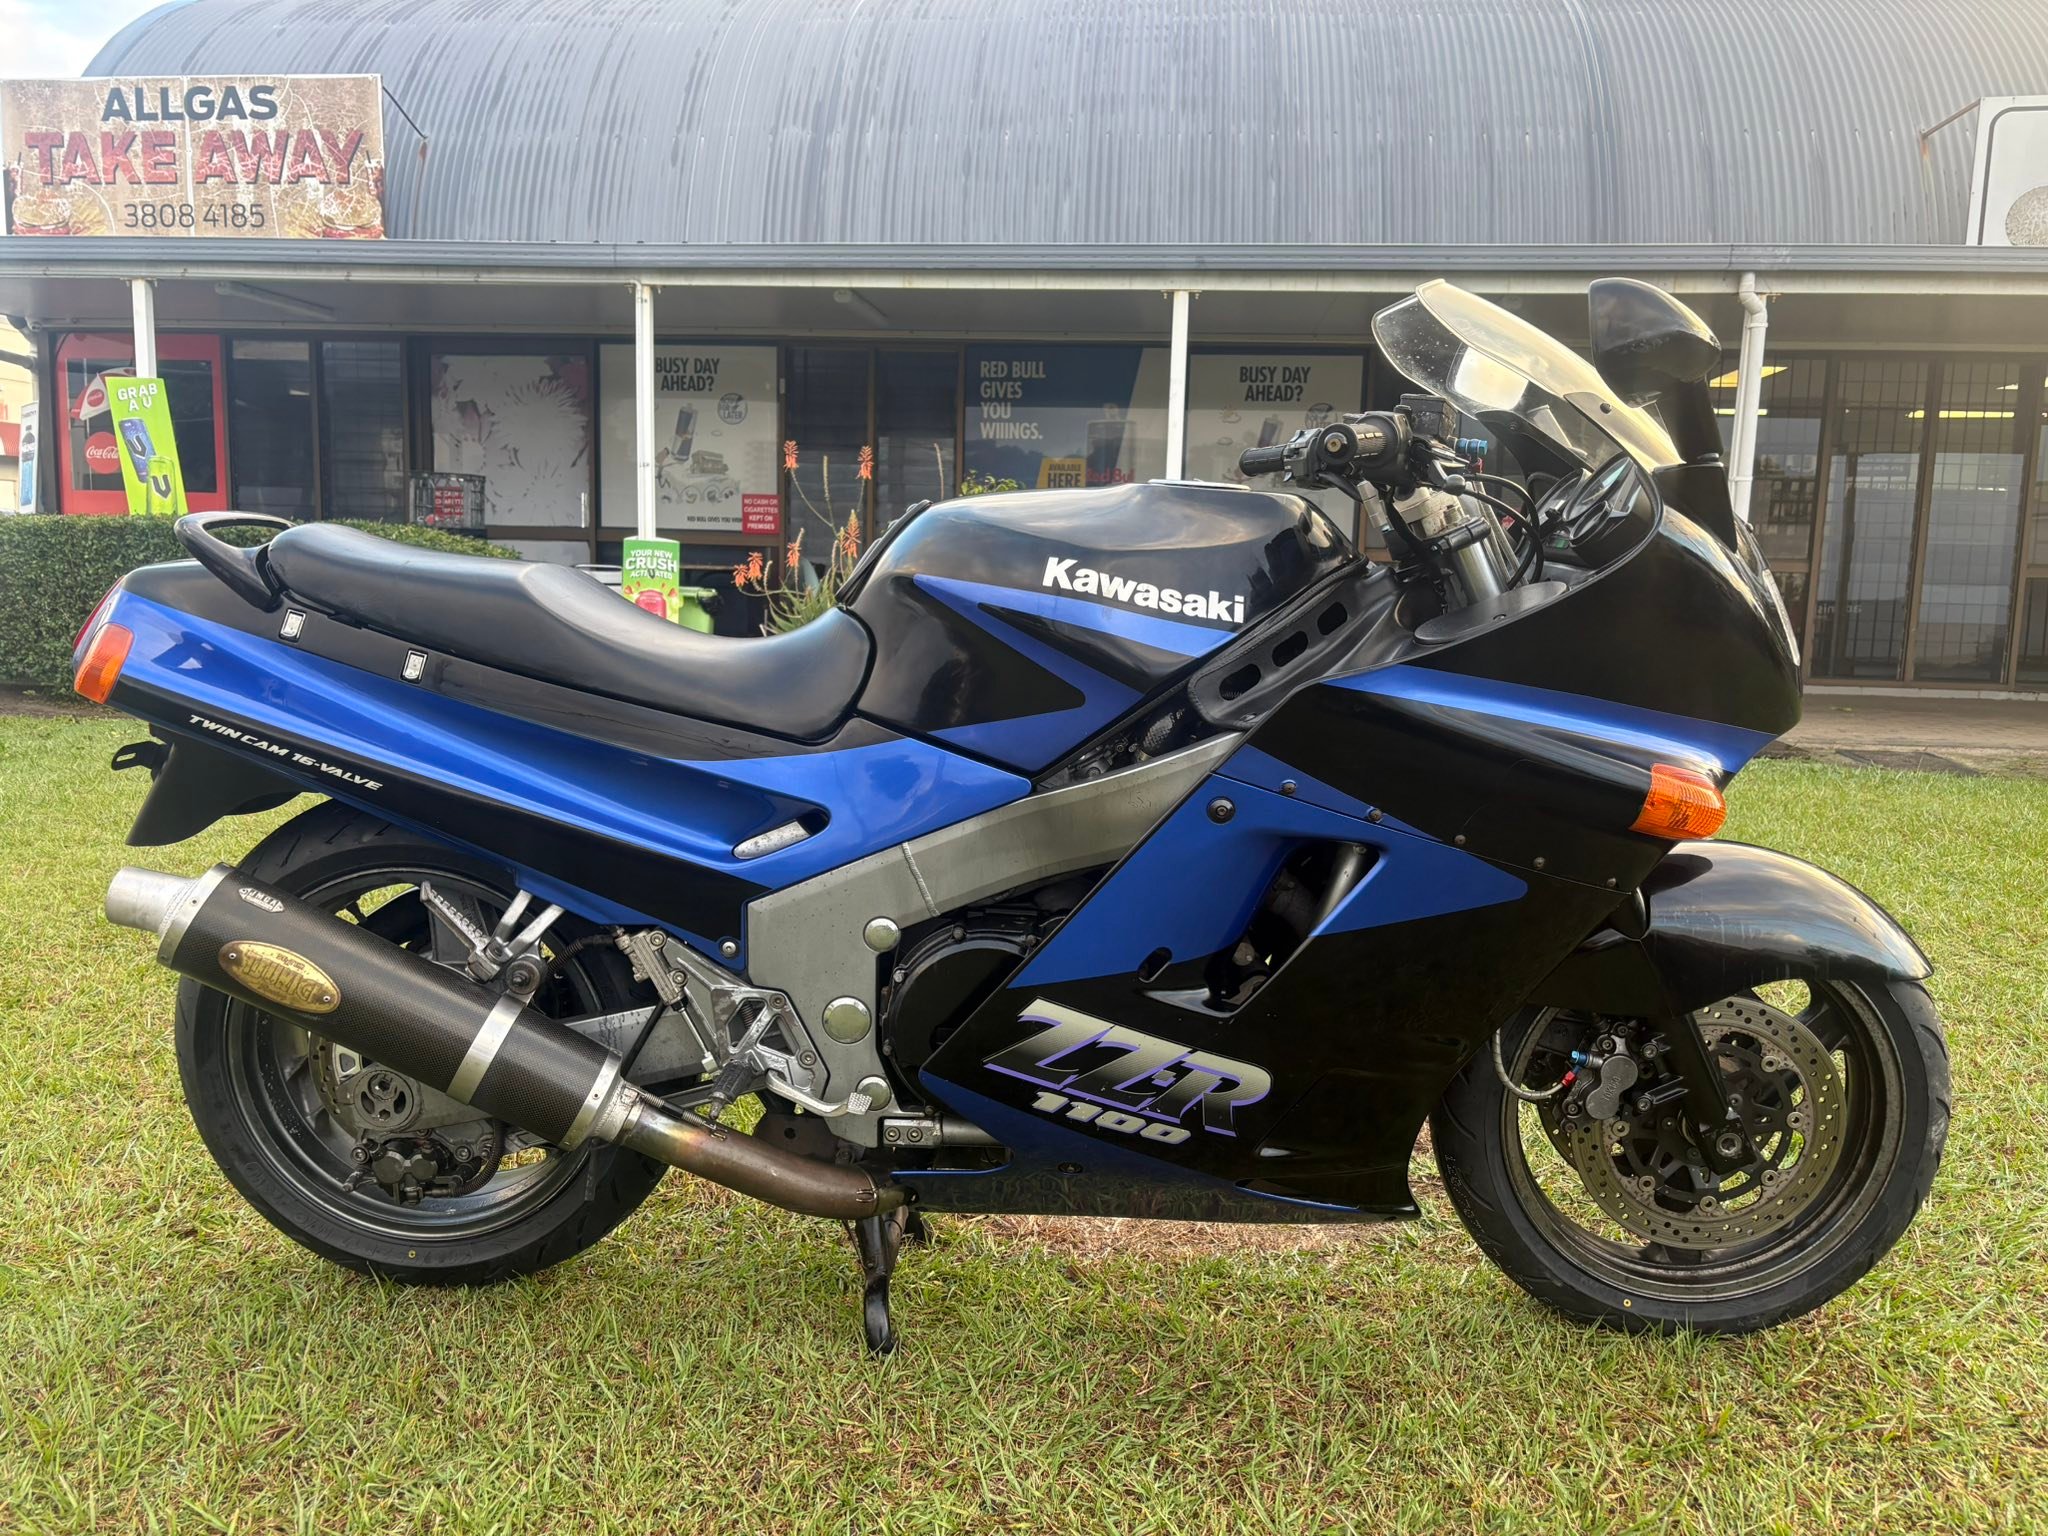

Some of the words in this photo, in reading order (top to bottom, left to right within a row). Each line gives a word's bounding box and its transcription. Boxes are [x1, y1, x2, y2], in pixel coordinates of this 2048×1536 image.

[101, 85, 278, 121] ALLGAS
[24, 130, 178, 185] TAKE
[195, 129, 364, 185] AWAY
[124, 203, 195, 228] 3808
[203, 203, 266, 228] 4185
[656, 358, 689, 374] BUSY
[694, 358, 720, 375] DAY
[980, 361, 1008, 378] RED
[1012, 361, 1046, 379] BULL
[1240, 366, 1278, 383] BUSY
[1282, 366, 1311, 384] DAY
[117, 383, 158, 401] GRAB
[661, 375, 714, 392] AHEAD?
[980, 381, 1023, 399] GIVES
[1245, 385, 1304, 402] AHEAD?
[129, 400, 139, 412] A
[980, 402, 1012, 419] YOU
[980, 422, 1044, 440] WIIINGS.
[1048, 463, 1082, 472] AVAILABLE
[1048, 473, 1082, 488] HERE
[630, 549, 652, 558] YOUR
[654, 550, 673, 559] NEW
[625, 557, 677, 573] CRUSH
[1042, 556, 1245, 624] Kawasaki
[188, 714, 242, 739] TWIN
[240, 735, 290, 757] CAM
[291, 752, 384, 791] 16-VALVE
[1030, 1090, 1193, 1145] 1100
